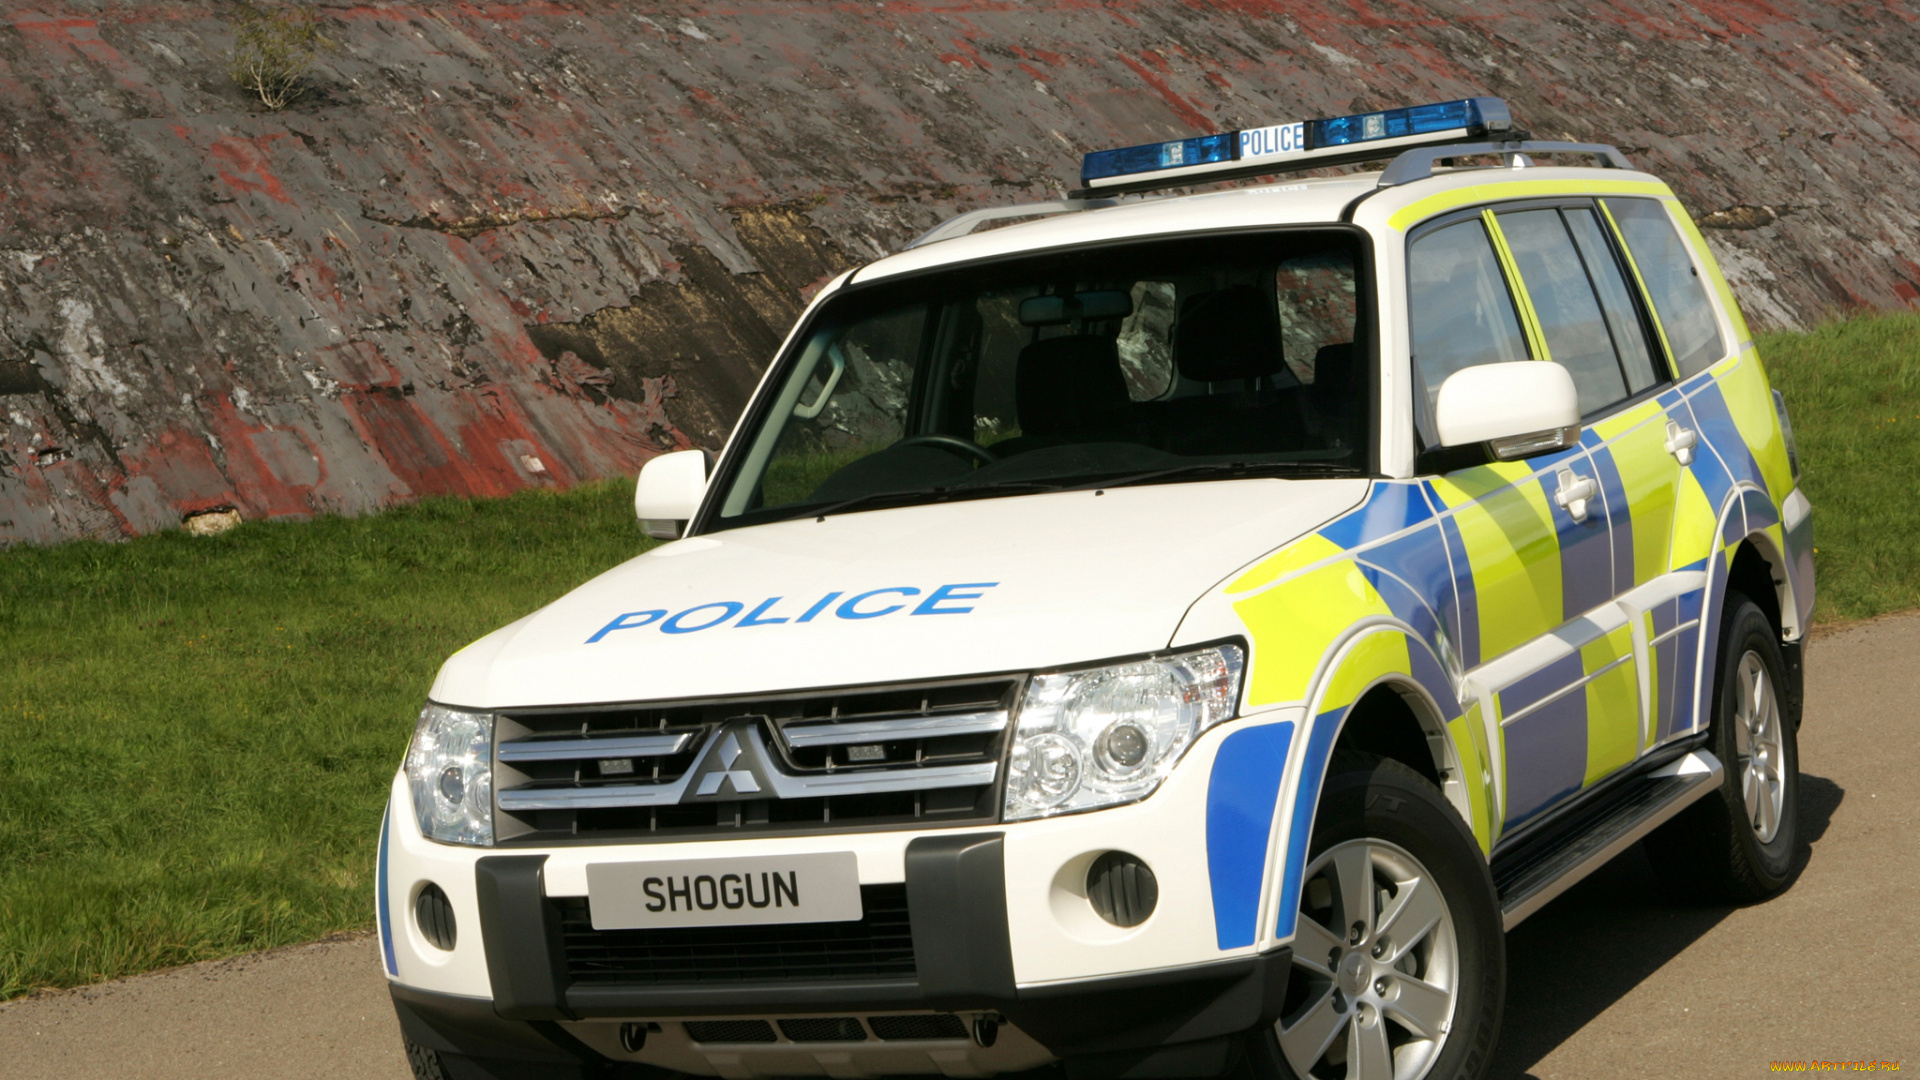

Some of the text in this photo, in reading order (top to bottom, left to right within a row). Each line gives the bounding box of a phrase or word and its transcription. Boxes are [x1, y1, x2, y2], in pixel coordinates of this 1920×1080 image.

[1240, 124, 1304, 157] POLICE
[583, 581, 1001, 644] POLICE
[642, 870, 800, 912] SHOGUN
